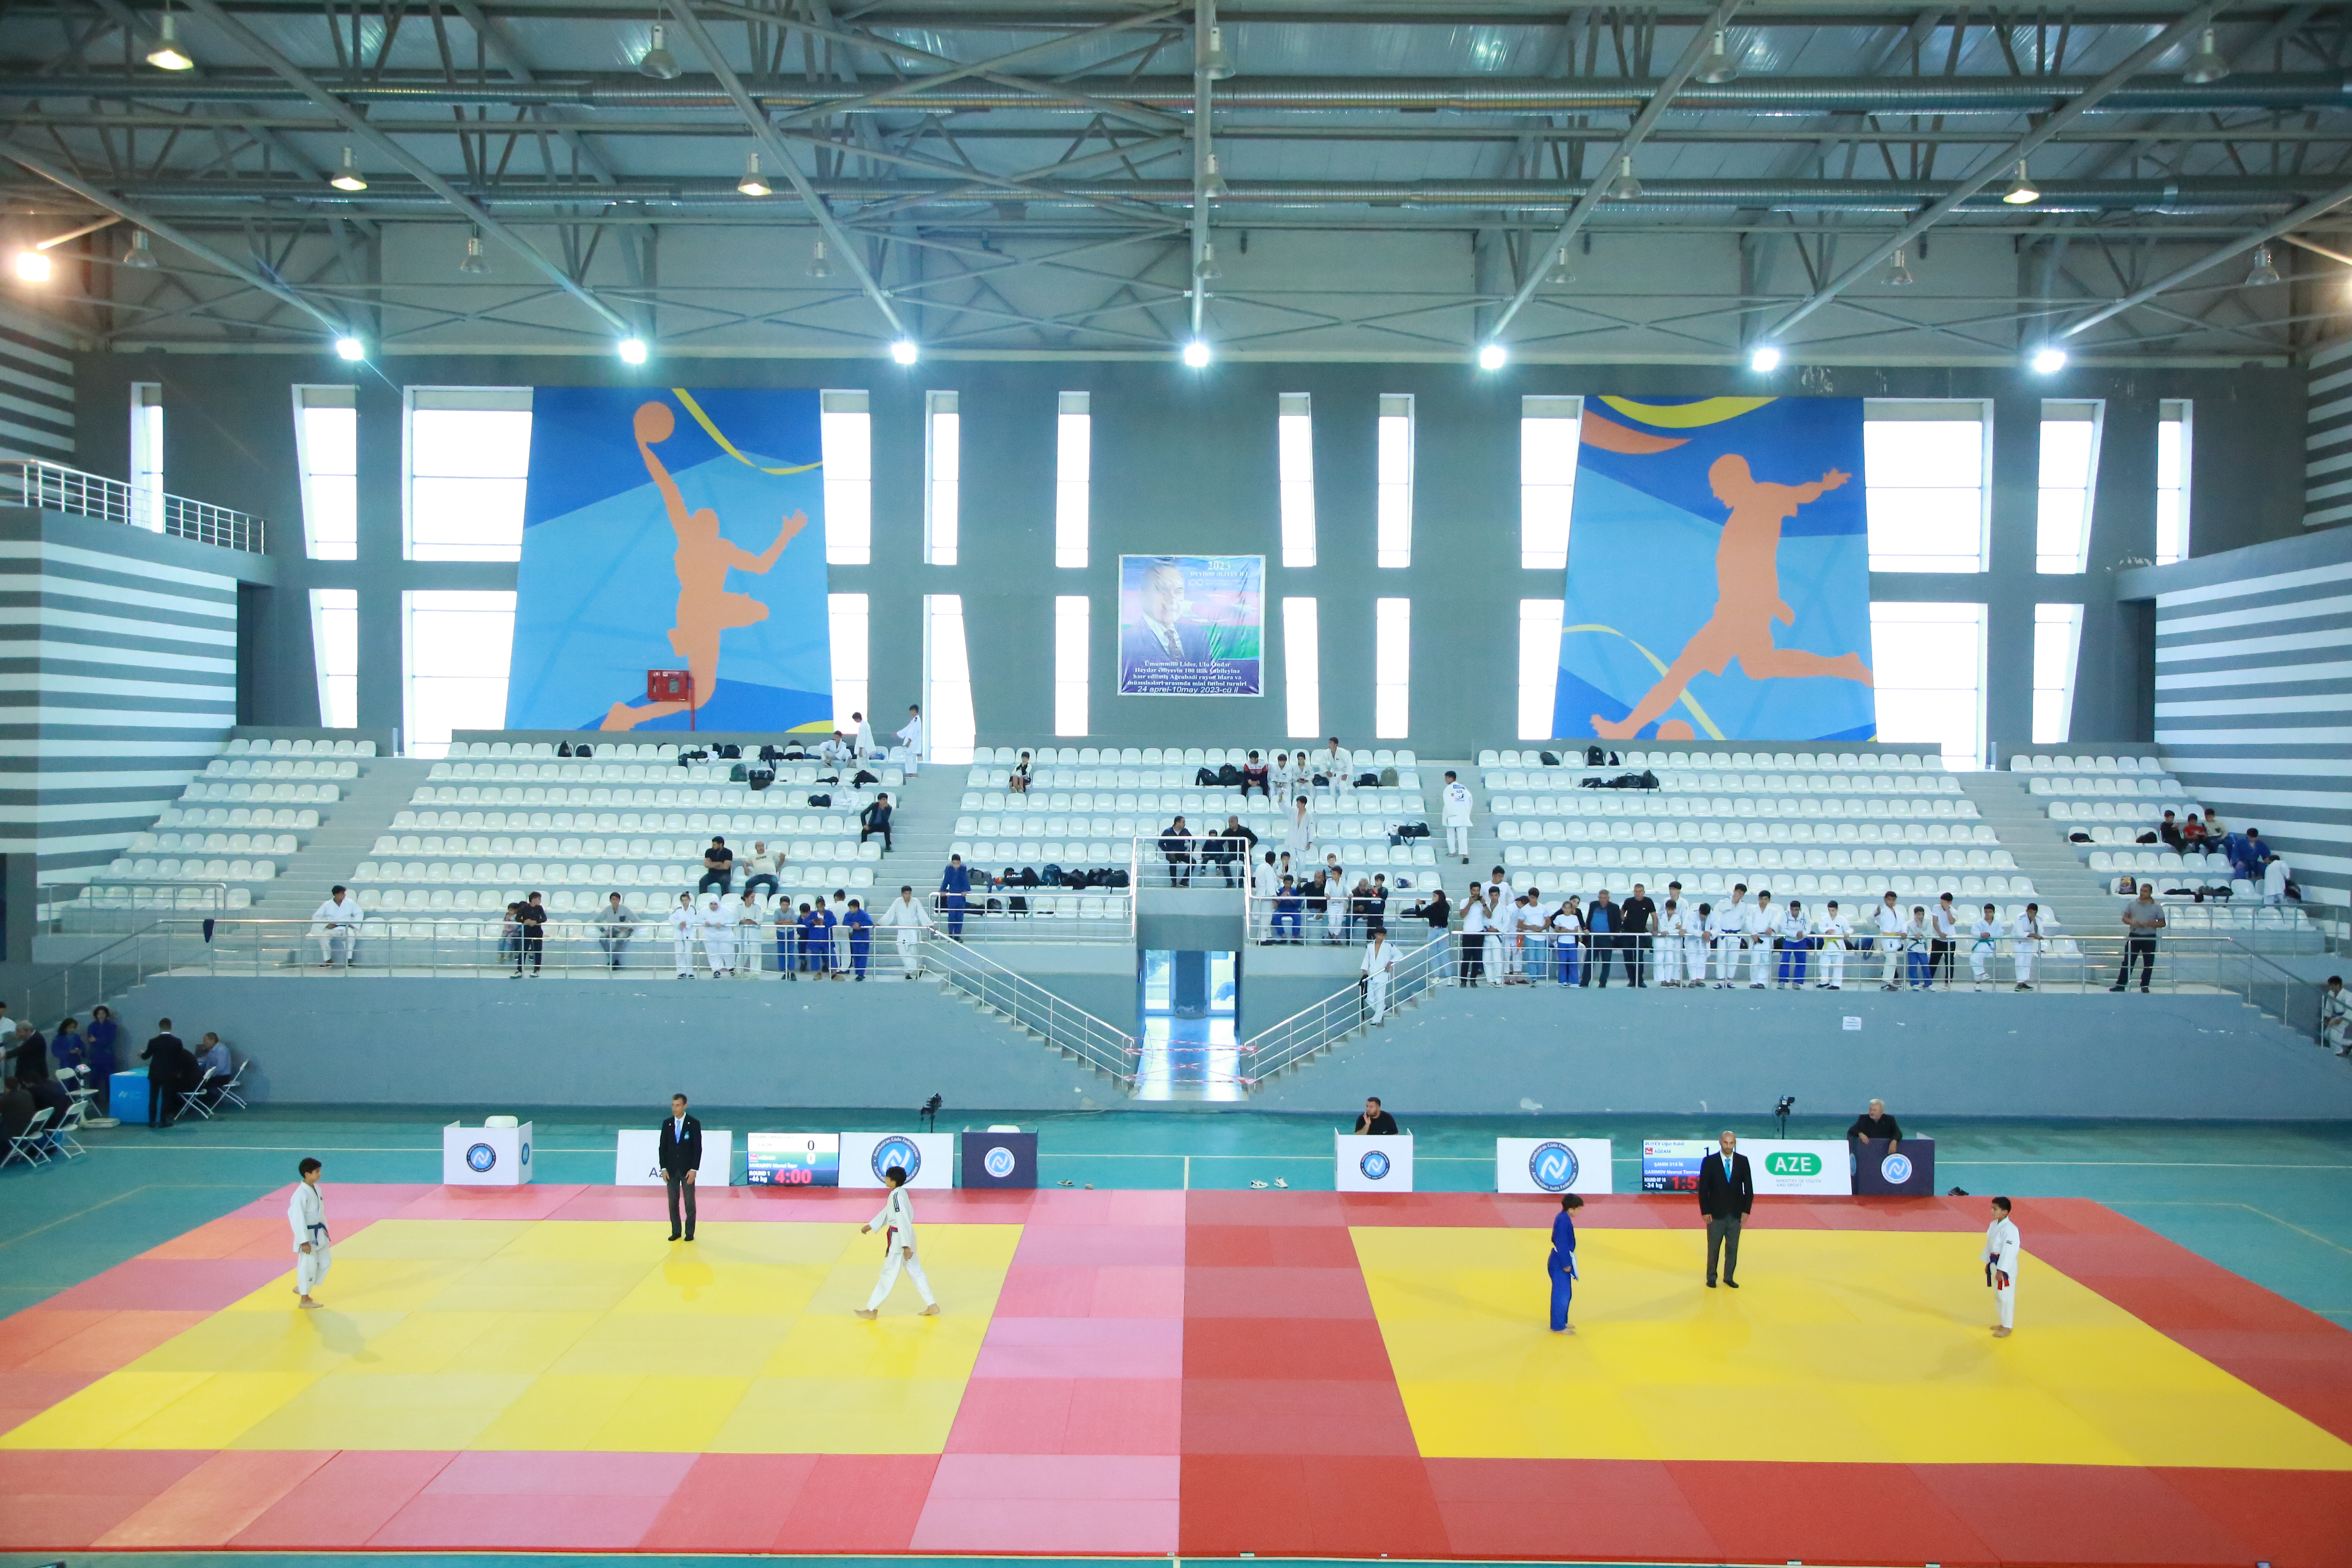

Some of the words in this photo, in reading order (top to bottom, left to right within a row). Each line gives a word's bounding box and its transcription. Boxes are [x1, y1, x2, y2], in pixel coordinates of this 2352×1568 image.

[1207, 561, 1231, 570] 2023
[807, 1140, 815, 1151] 0
[1704, 1147, 1709, 1157] 1
[806, 1152, 816, 1165] 0
[1774, 1156, 1812, 1172] AZE
[775, 1169, 812, 1184] 4:00
[1672, 1176, 1700, 1189] 1:5
